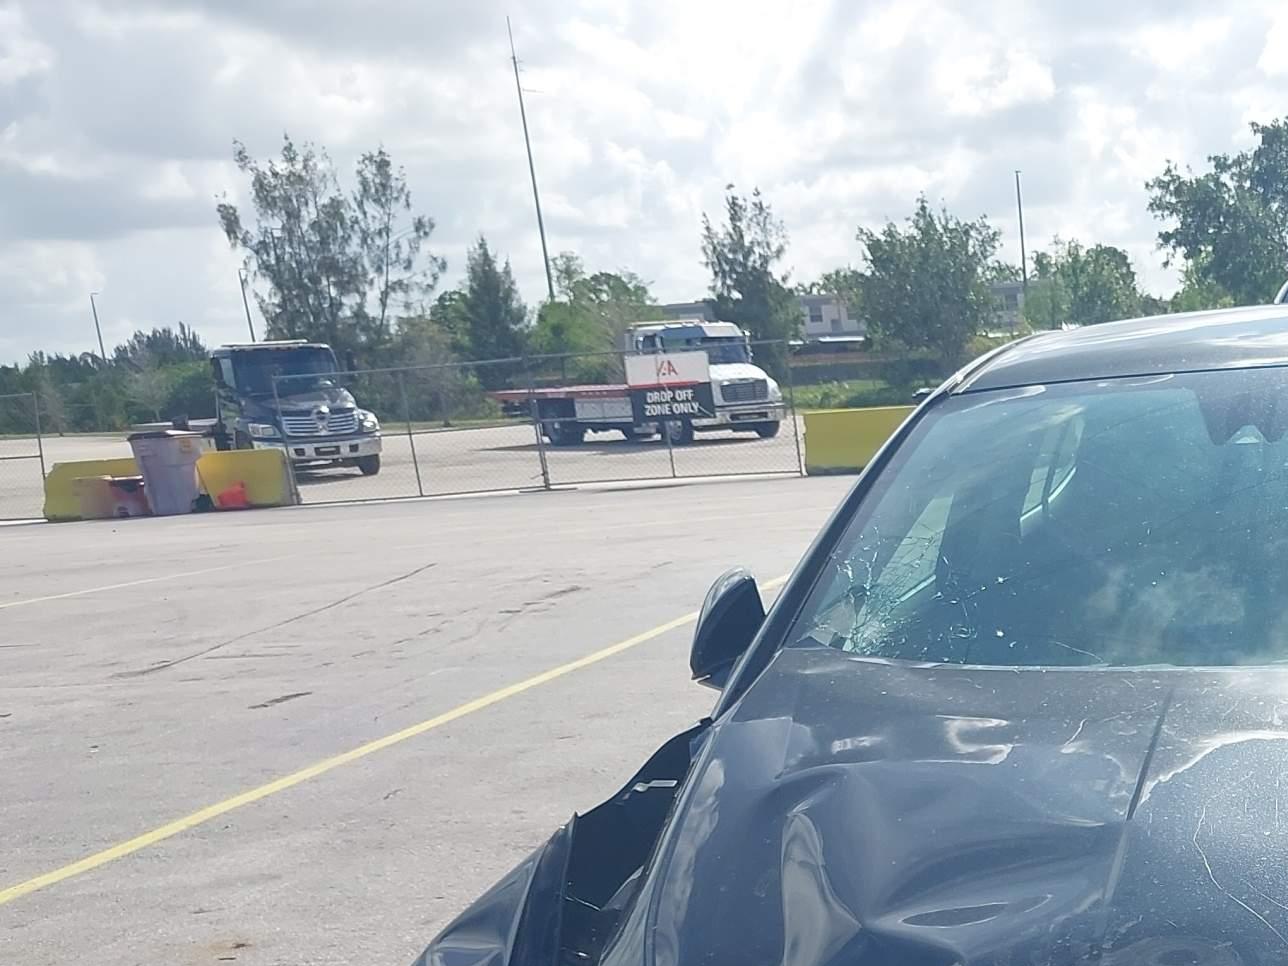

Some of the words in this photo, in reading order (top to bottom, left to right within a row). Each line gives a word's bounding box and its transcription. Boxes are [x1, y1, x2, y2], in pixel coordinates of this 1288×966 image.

[647, 391, 674, 403] DROP
[675, 389, 694, 401] OFF
[644, 403, 671, 416] ZONE
[672, 402, 699, 414] ONLY
